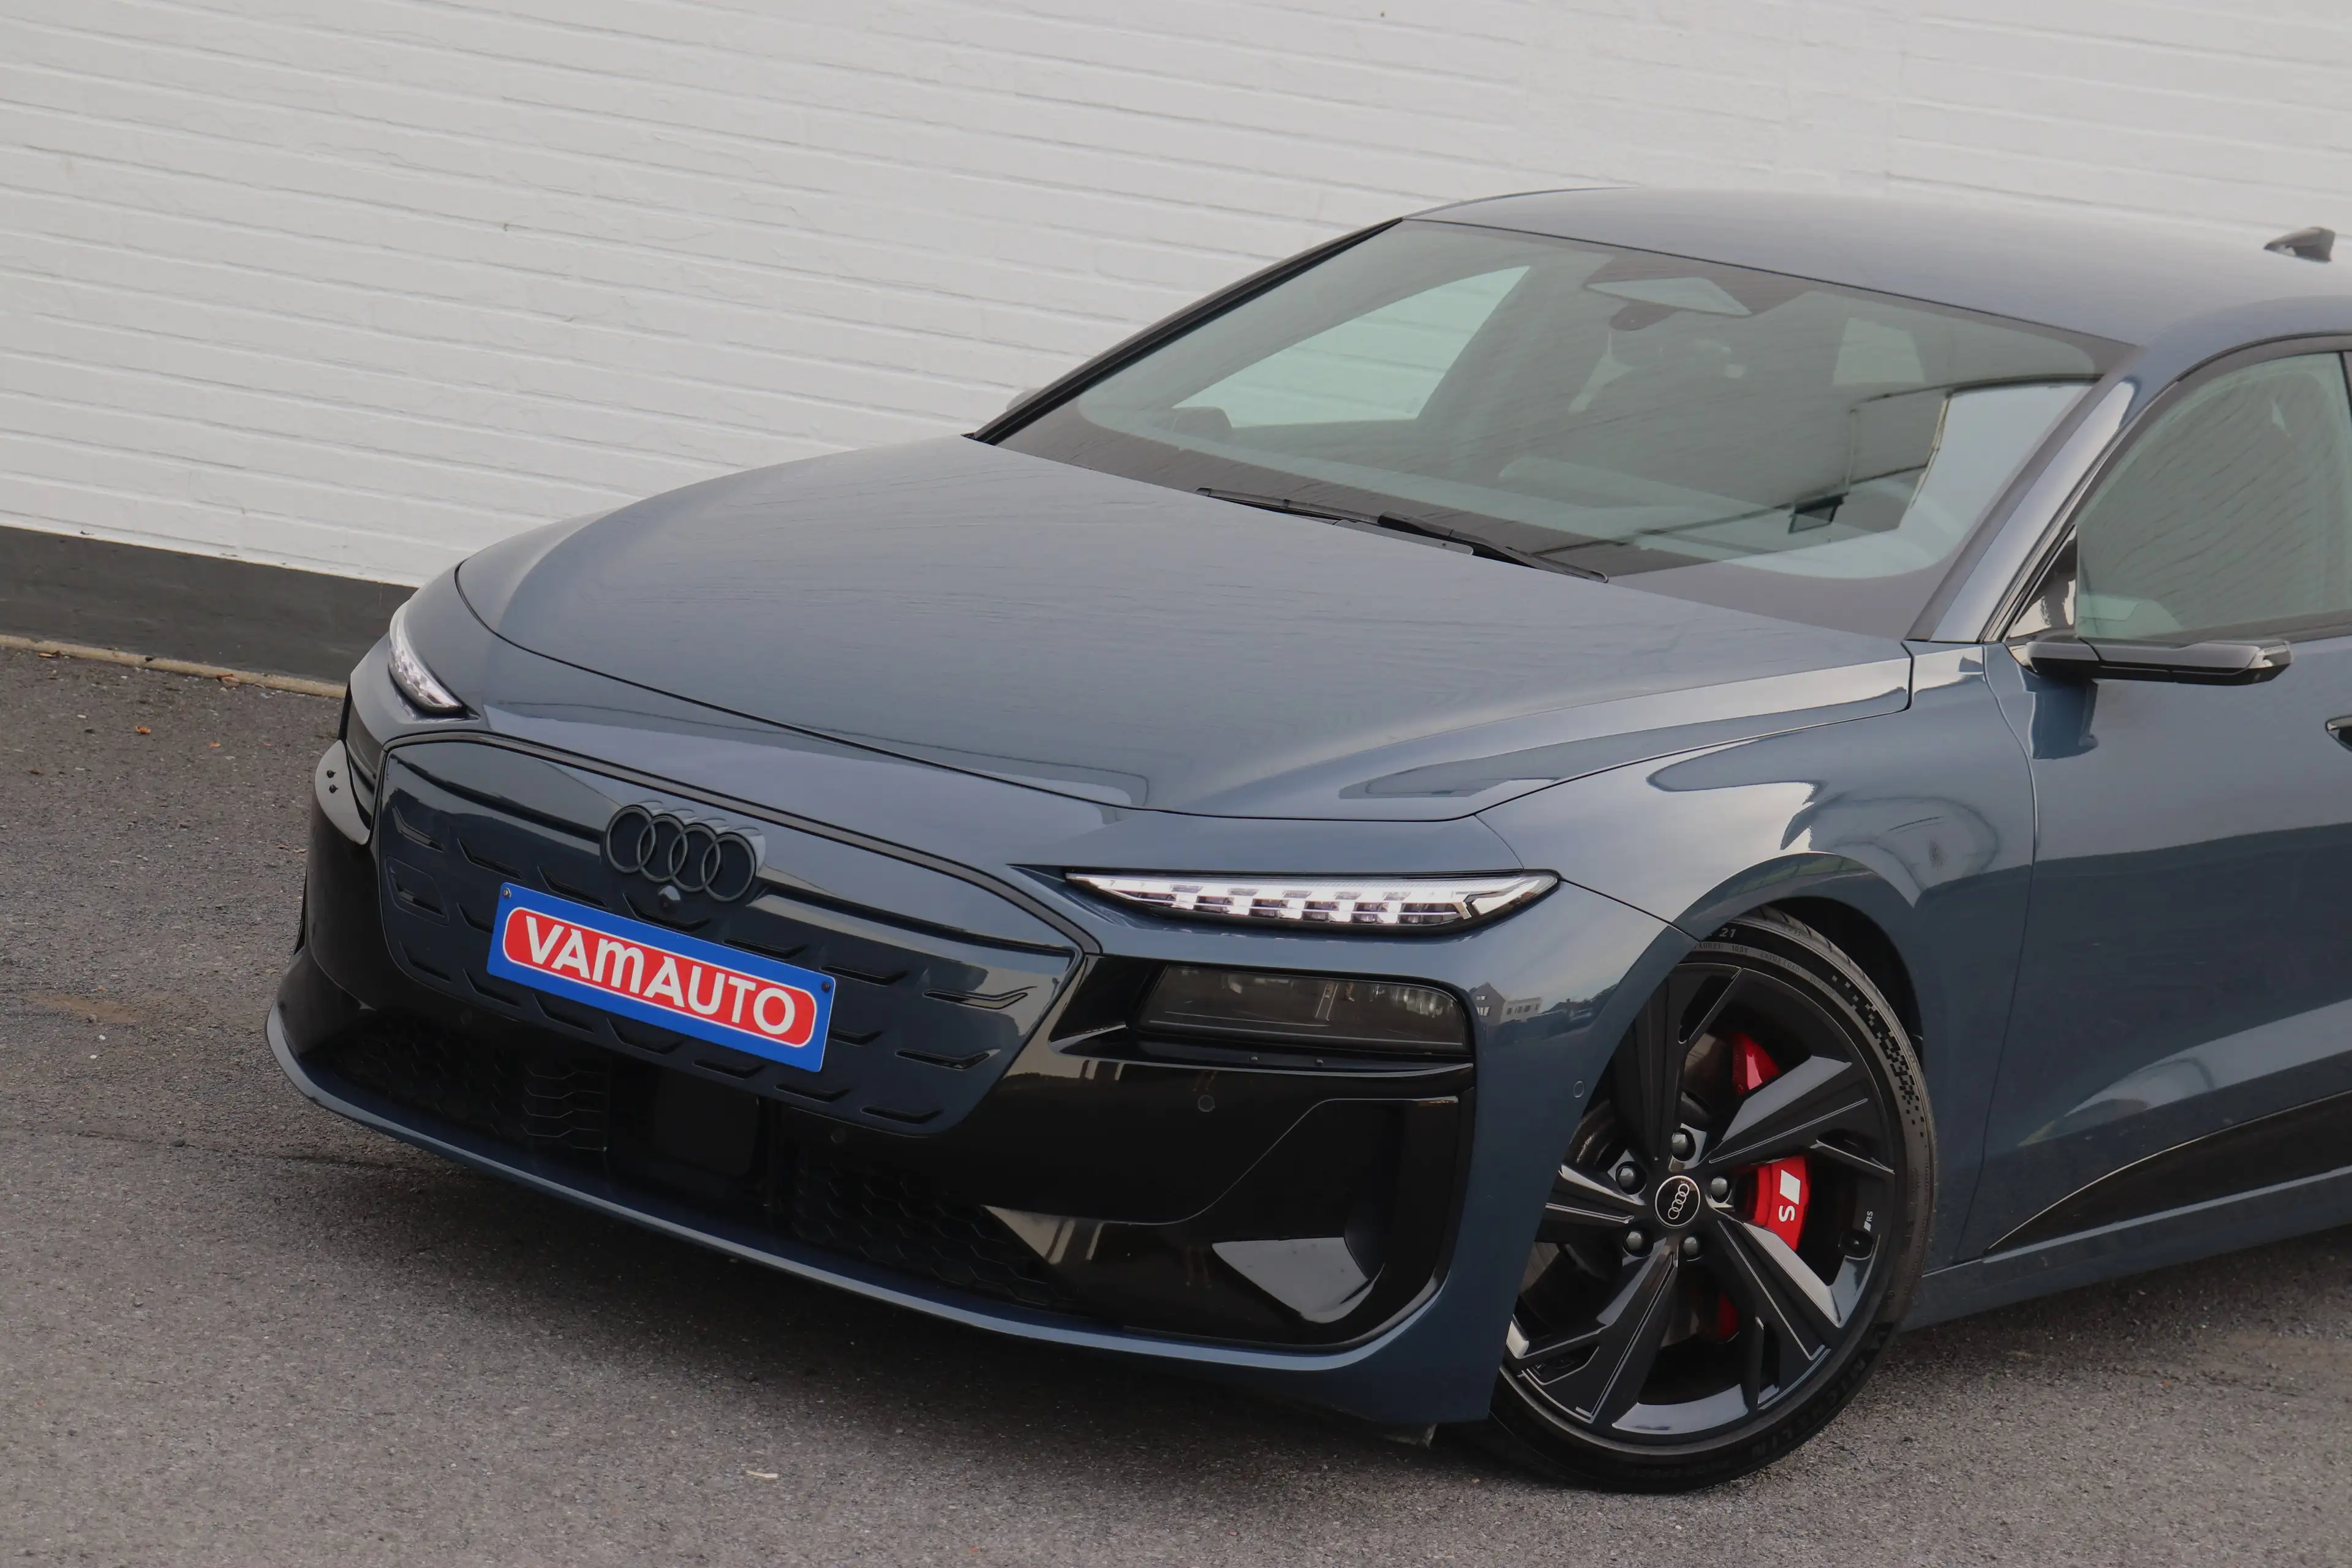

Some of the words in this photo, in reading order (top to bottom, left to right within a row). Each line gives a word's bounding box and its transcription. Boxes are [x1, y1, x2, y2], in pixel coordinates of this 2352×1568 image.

[1719, 927, 1736, 938] 21
[1760, 951, 1781, 963] EXTRA
[1783, 960, 1800, 973] LOAD
[525, 915, 796, 1035] VAMAUTO
[1778, 1205, 1796, 1223] S
[1866, 1210, 1874, 1222] RS
